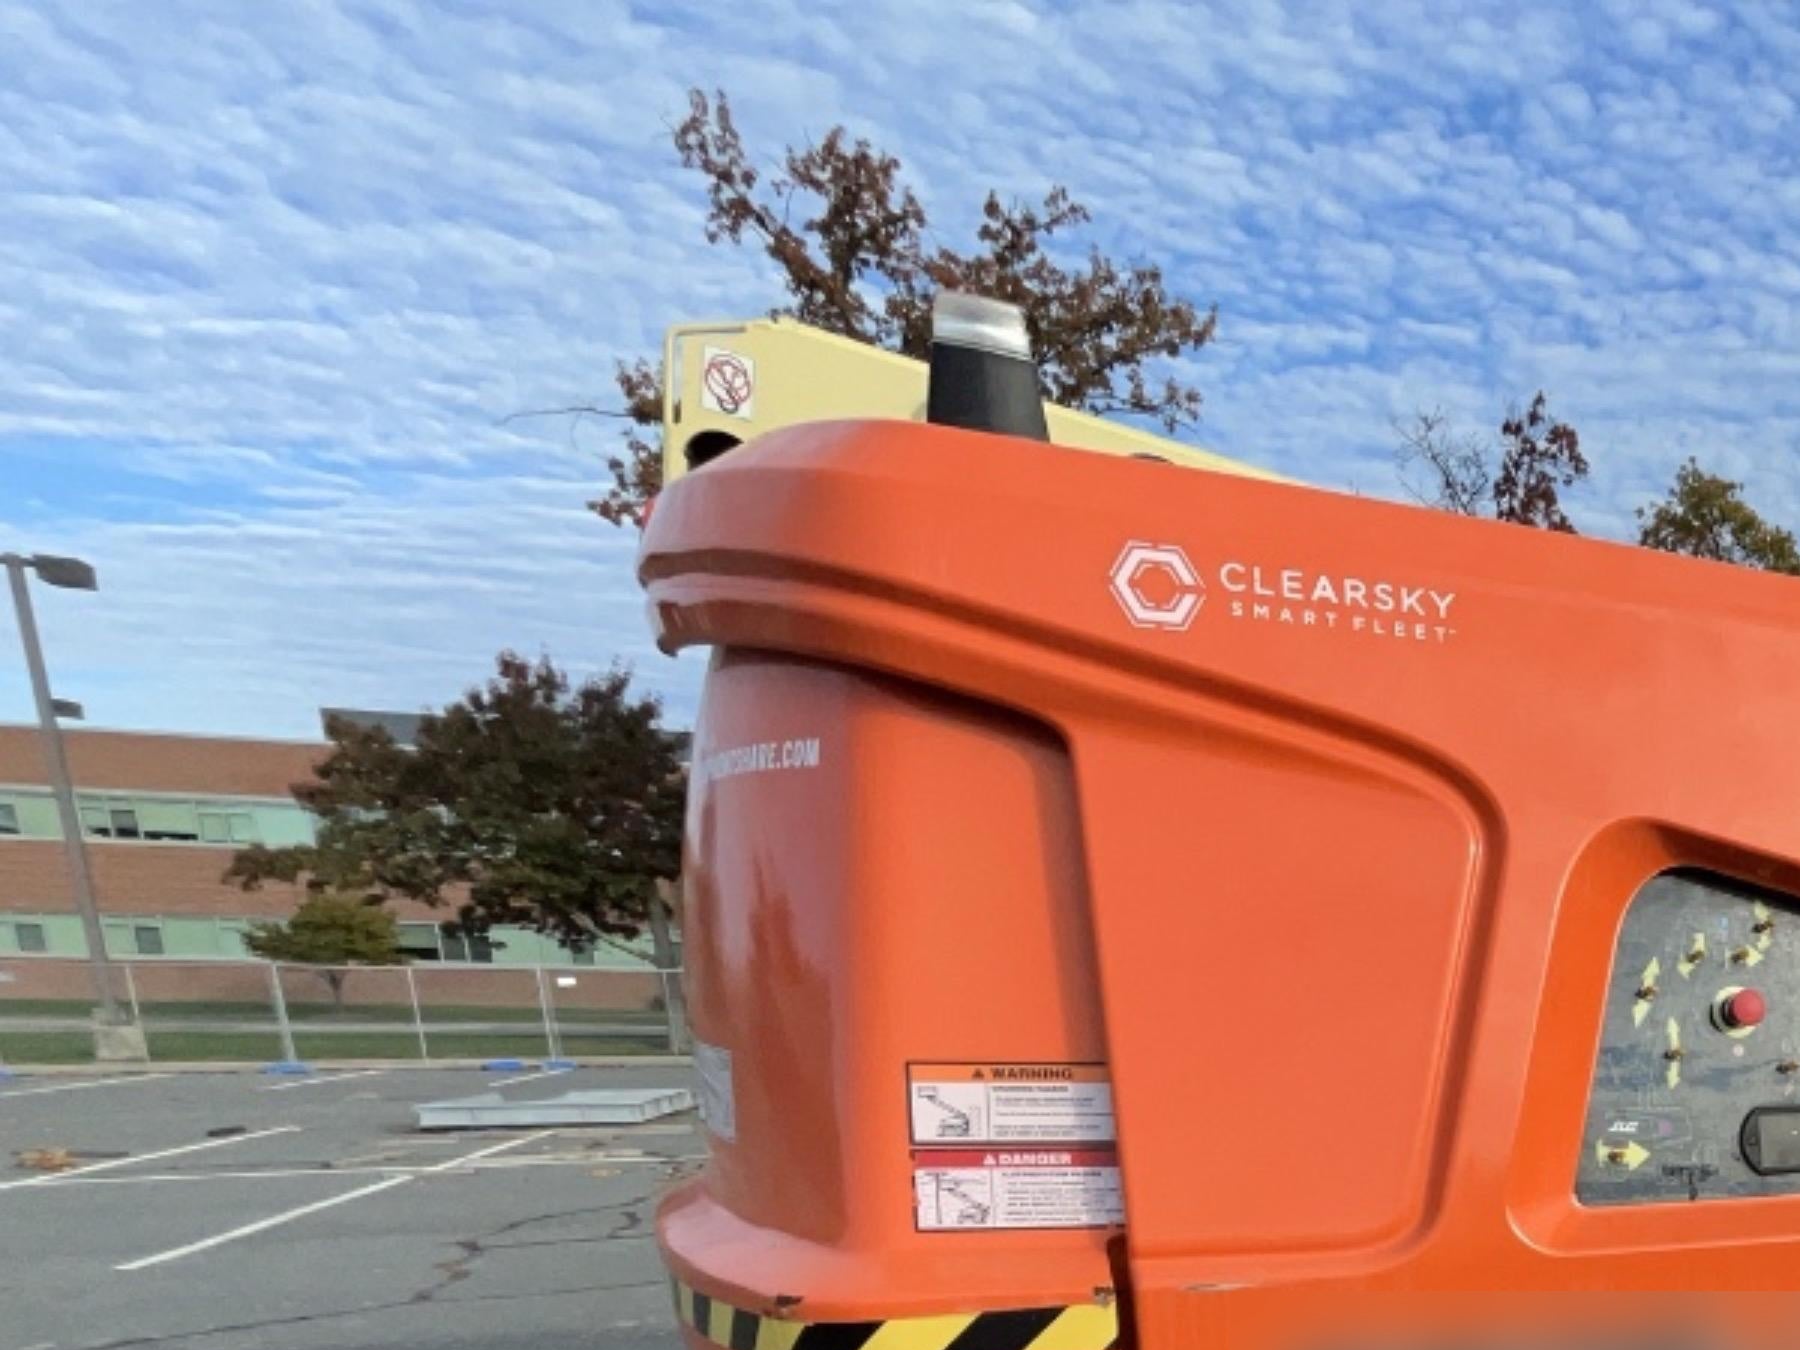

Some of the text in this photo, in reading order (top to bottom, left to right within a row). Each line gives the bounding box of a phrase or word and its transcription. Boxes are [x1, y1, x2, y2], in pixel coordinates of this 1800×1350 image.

[1220, 562, 1456, 619] CLEARSKY
[1231, 601, 1338, 628] SMART
[991, 1067, 1073, 1080] WARNING
[999, 1151, 1072, 1166] DANGER
